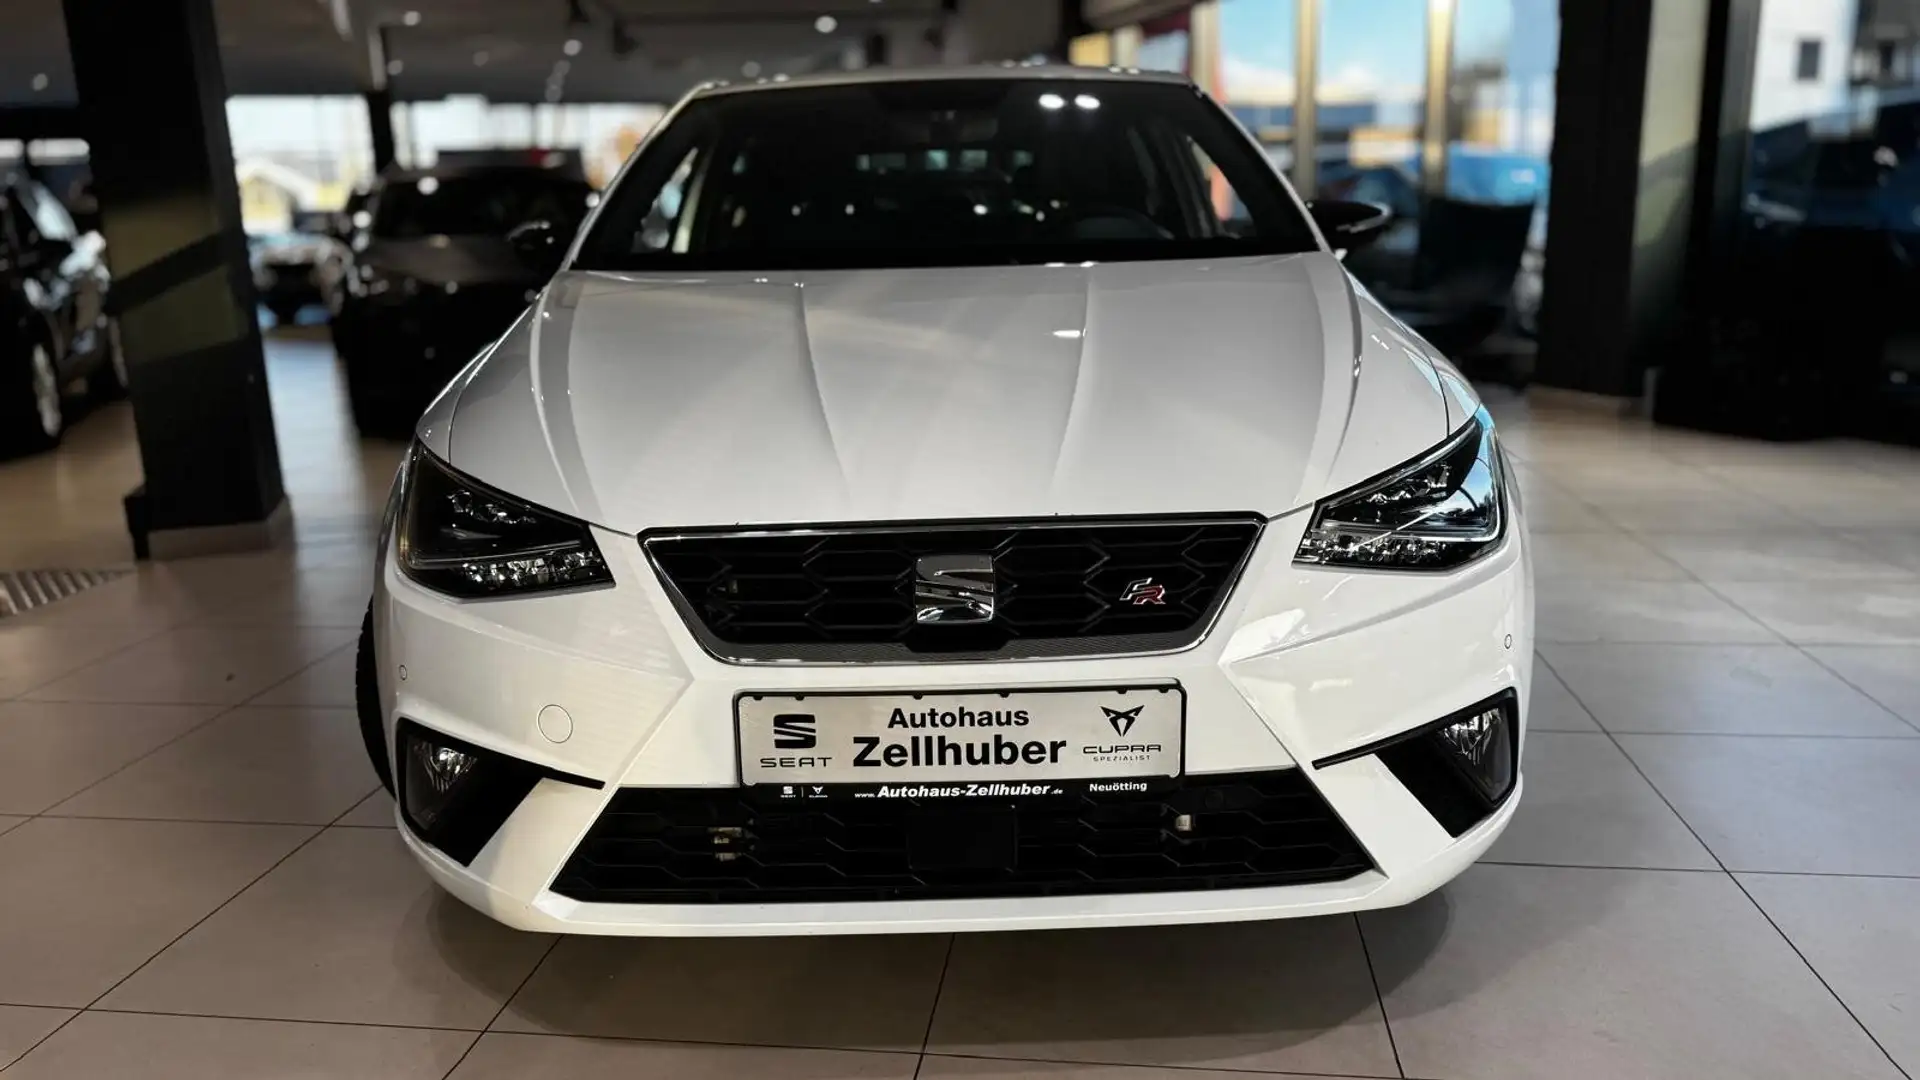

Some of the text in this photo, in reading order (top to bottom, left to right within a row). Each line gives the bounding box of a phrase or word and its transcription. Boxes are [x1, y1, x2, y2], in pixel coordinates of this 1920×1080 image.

[1119, 577, 1167, 605] FR
[887, 706, 1030, 729] Autohaus
[852, 734, 1067, 767] Zellhuber
[1082, 744, 1162, 754] CUPRA
[760, 757, 832, 768] SEAT
[1089, 781, 1148, 792] Neuötting
